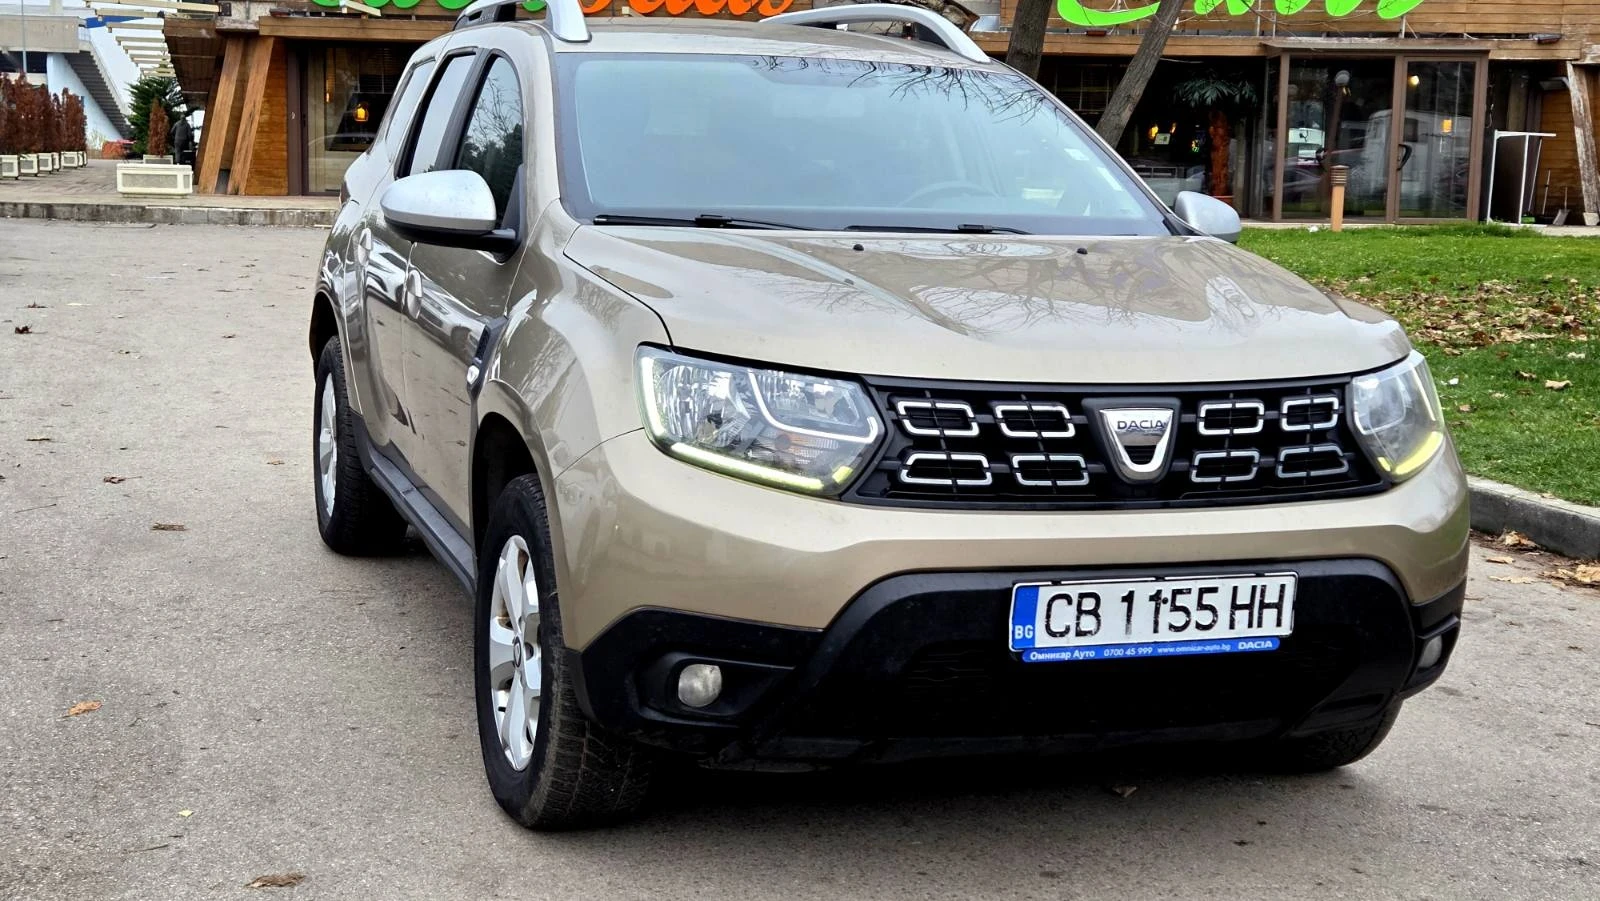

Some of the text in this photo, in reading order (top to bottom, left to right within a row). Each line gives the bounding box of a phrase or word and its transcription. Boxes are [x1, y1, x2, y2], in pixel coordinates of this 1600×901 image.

[1117, 420, 1165, 430] DACIA
[1044, 583, 1286, 638] CB 1155 HH
[1014, 624, 1034, 640] BG
[1030, 650, 1071, 660] Омникар
[1073, 649, 1096, 660] Ауто
[1103, 647, 1124, 657] 0700
[1138, 646, 1153, 655] 999
[1238, 640, 1273, 650] DACIA
